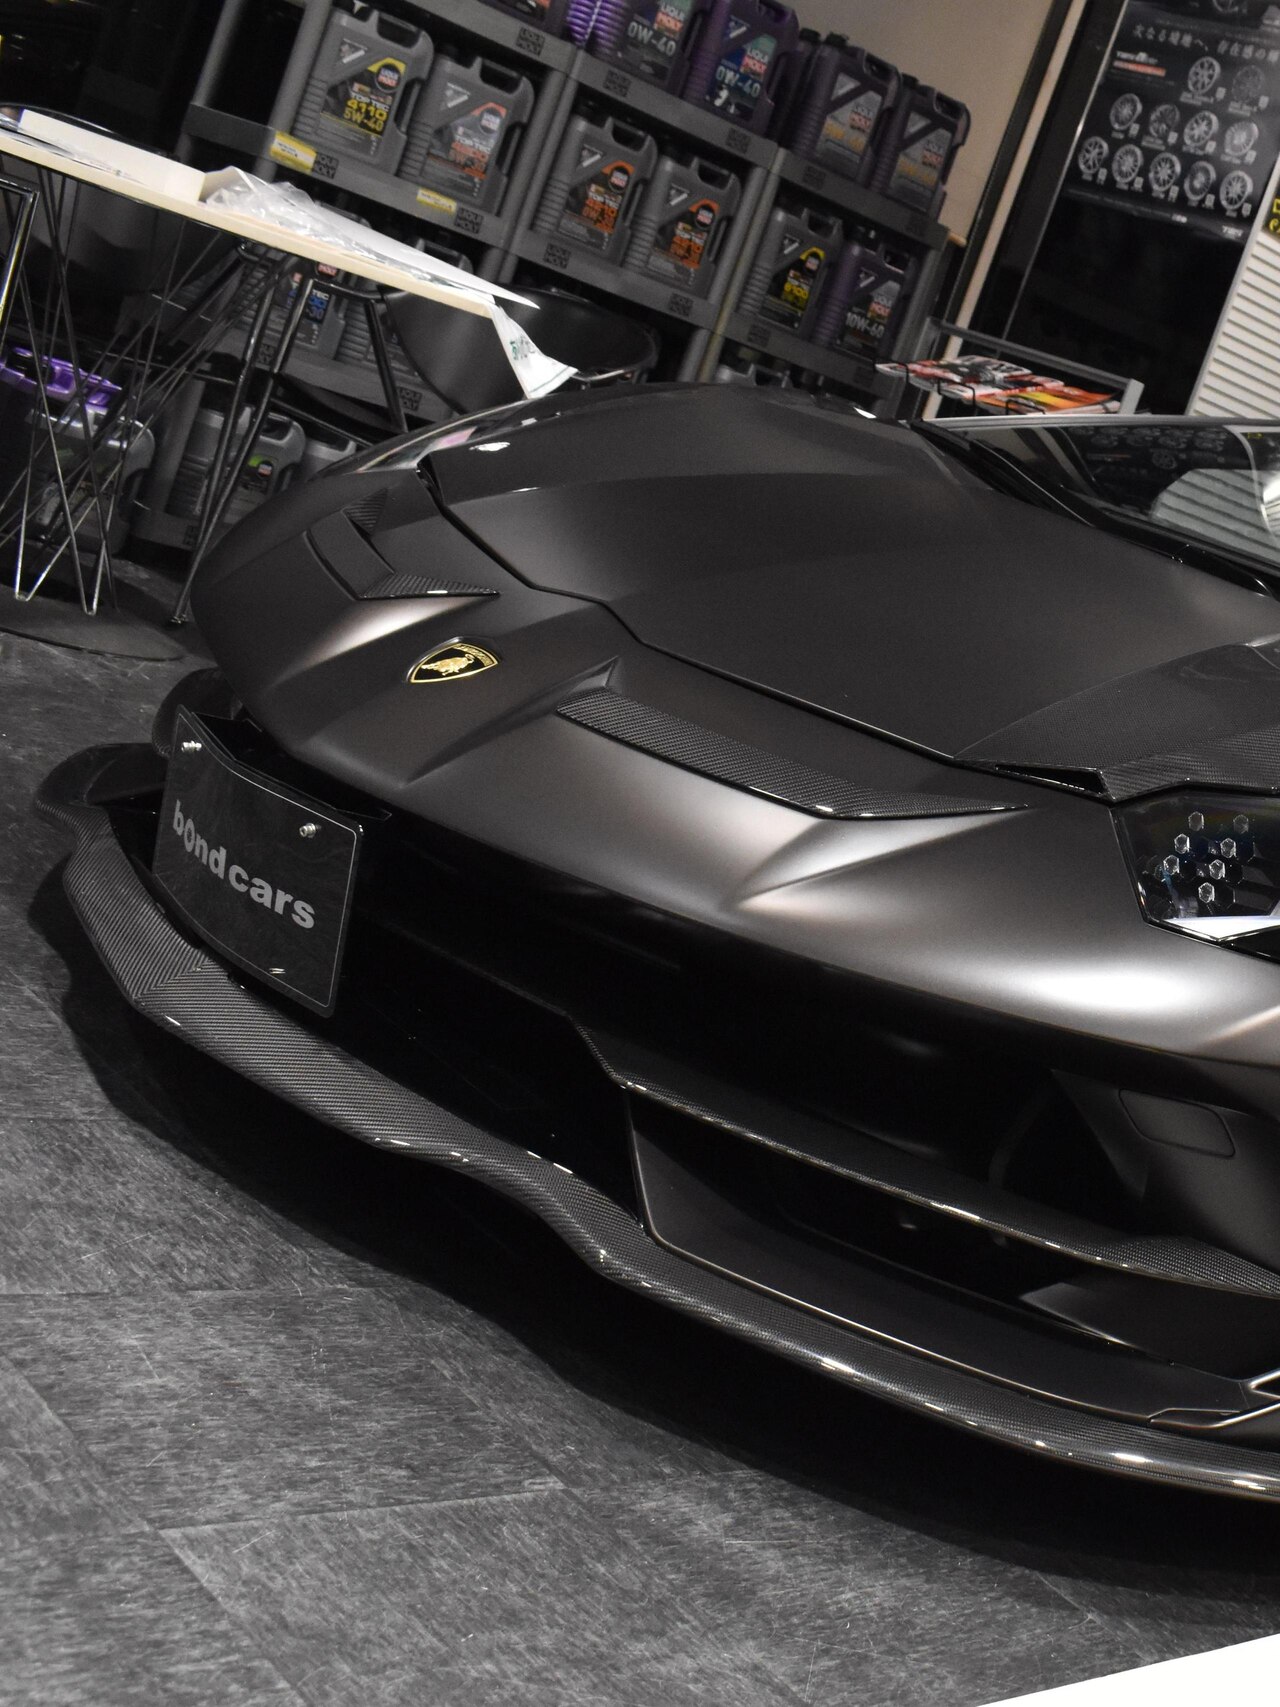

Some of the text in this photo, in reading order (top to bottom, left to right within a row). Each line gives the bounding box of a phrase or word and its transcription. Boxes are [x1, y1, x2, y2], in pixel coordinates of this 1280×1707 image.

[628, 21, 677, 57] 0W-40
[716, 66, 760, 98] 0W-40
[343, 107, 384, 132] 5W-40
[347, 99, 388, 122] 4110
